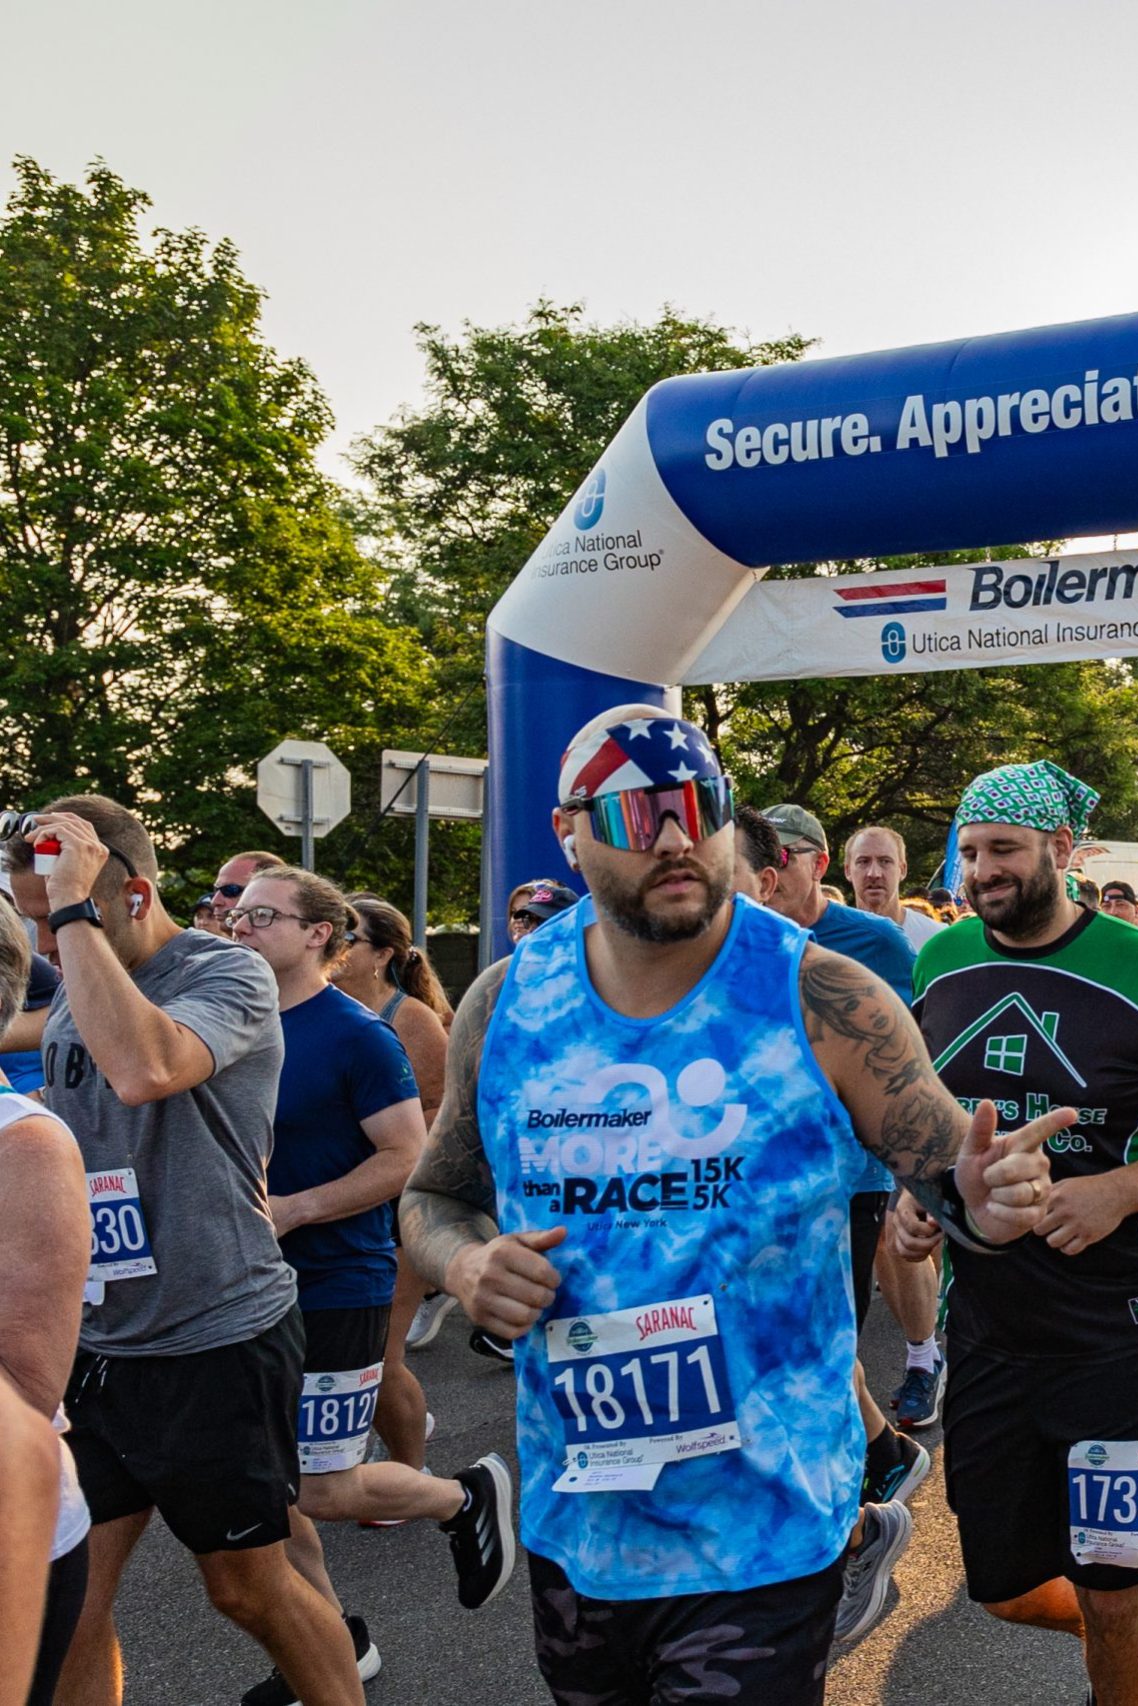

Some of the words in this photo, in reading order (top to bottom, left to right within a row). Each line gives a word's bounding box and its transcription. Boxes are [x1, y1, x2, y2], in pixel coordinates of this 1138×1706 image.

[704, 412, 882, 471] Secure.
[574, 530, 643, 553] National
[912, 632, 961, 655] Utica
[967, 624, 1048, 649] National
[527, 1108, 651, 1129] Boilermaker
[518, 1133, 663, 1175] MORE
[690, 1156, 745, 1184] 15K
[89, 1175, 127, 1197] SARANAC
[522, 1180, 560, 1197] than
[562, 1172, 689, 1215] RACE
[692, 1184, 732, 1211] 5K
[549, 1200, 560, 1213] a
[643, 1218, 668, 1228] York
[635, 1306, 699, 1342] SARANAC
[554, 1345, 722, 1432] 18171
[302, 1388, 378, 1436] 18121
[676, 1436, 727, 1454] Wolfspeed
